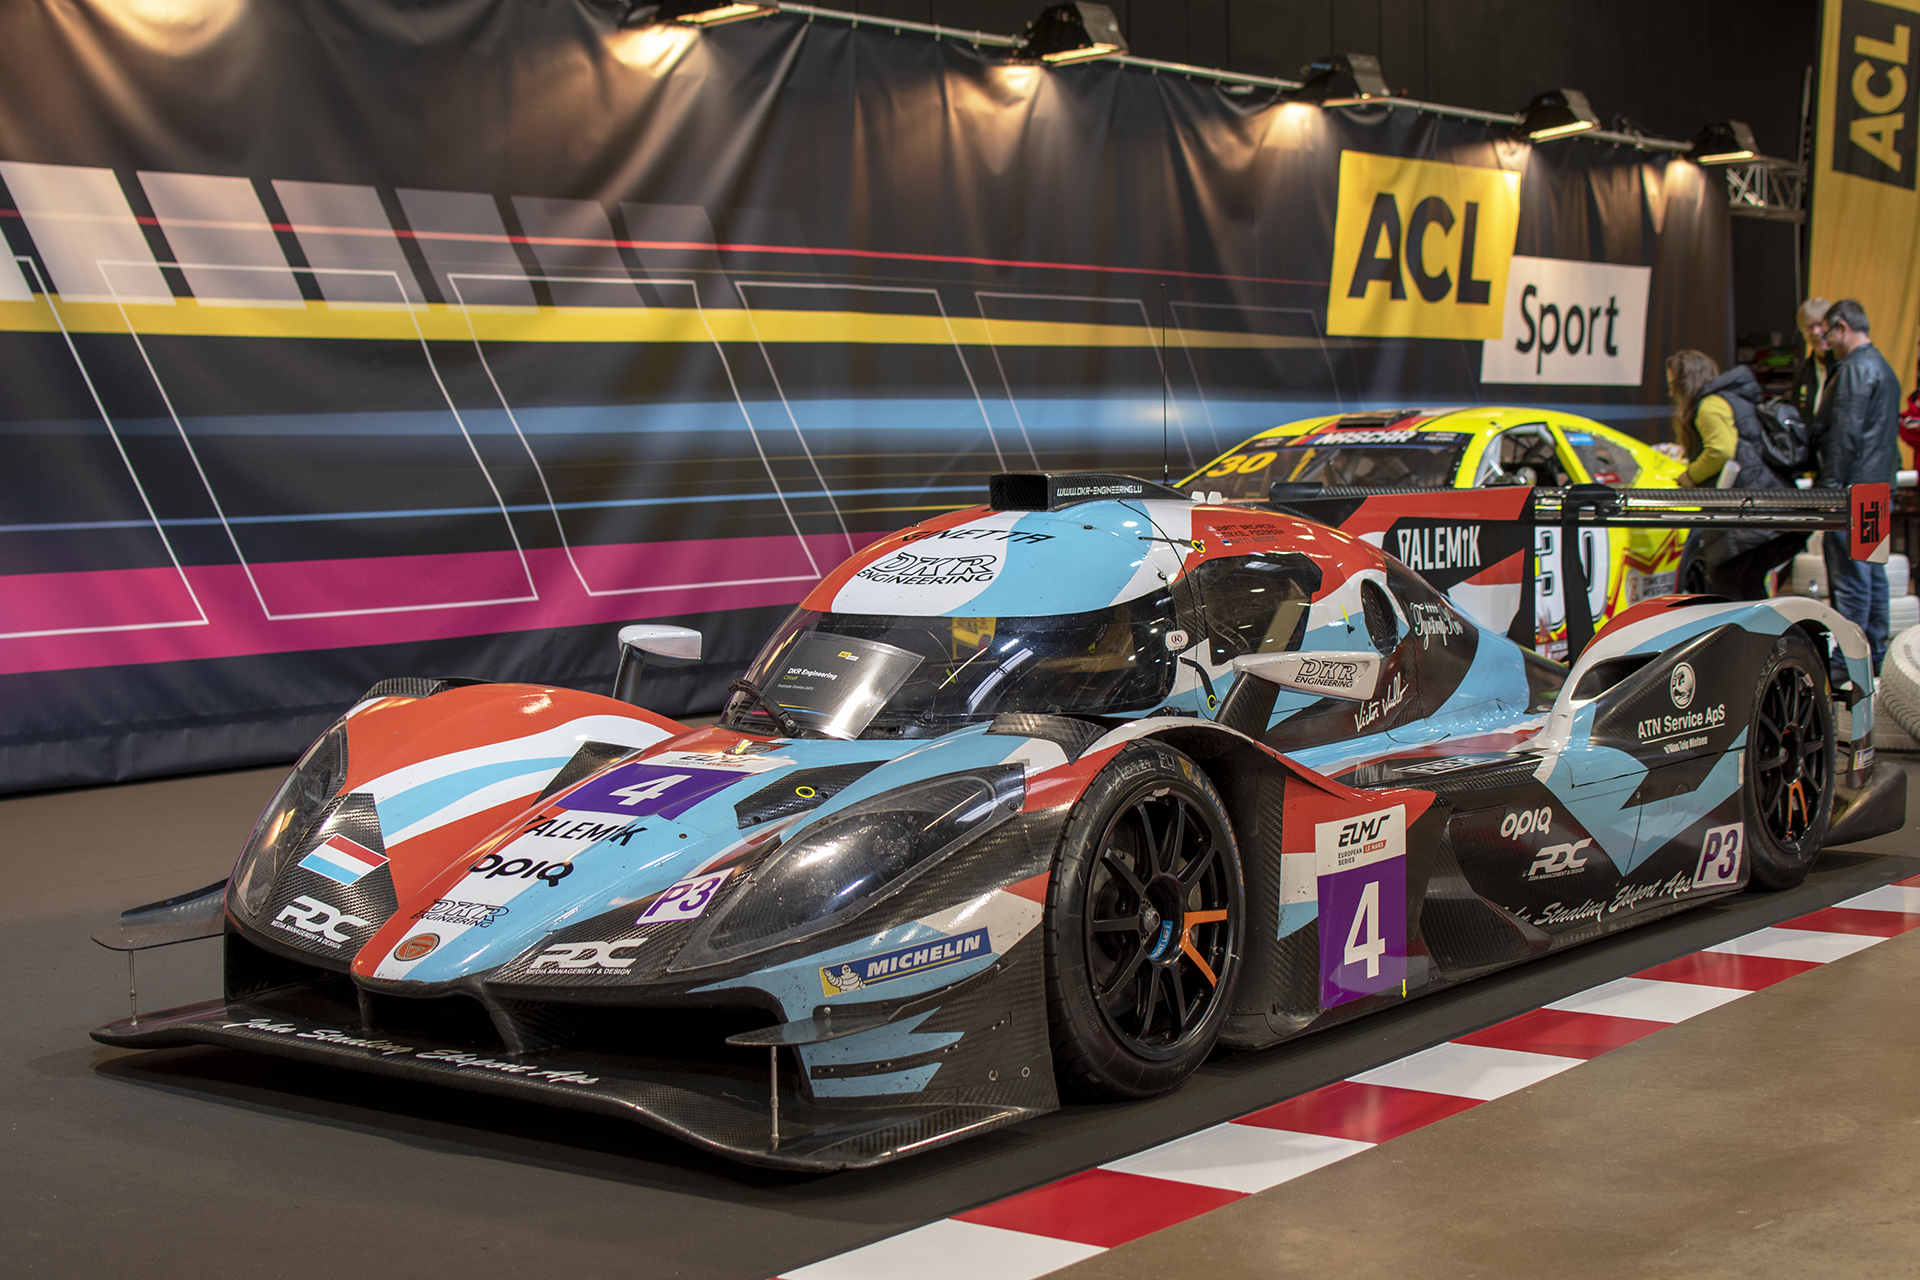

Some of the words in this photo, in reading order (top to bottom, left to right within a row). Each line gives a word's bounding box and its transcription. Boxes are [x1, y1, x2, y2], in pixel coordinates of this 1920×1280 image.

[1849, 24, 1911, 173] ACL
[1347, 191, 1491, 304] ACL
[1516, 284, 1620, 375] Sport
[1313, 430, 1418, 445] NASCAR
[1206, 451, 1278, 477] 30
[902, 529, 1056, 544] GINETTA
[856, 569, 995, 585] ENGINEERING
[871, 551, 997, 576] DKR
[801, 668, 838, 680] Engineering
[1294, 676, 1353, 688] ENGINEERING
[1298, 658, 1358, 680] DKR
[1638, 717, 1661, 739] ATN
[1664, 711, 1703, 732] Service
[1705, 704, 1725, 726] ApS
[609, 774, 692, 806] 4
[1338, 814, 1391, 847] ELMS
[1338, 848, 1363, 859] EUROPEAN
[1371, 841, 1384, 851] MANS
[1338, 857, 1355, 866] SERIES
[1528, 837, 1592, 876] RDC
[1696, 829, 1738, 881] P3
[421, 898, 509, 922] DKR
[645, 877, 721, 918] P3
[275, 895, 371, 942] RDC
[410, 911, 494, 928] ENGINEERING
[1344, 880, 1386, 979] 4
[270, 920, 286, 928] MEDIA
[284, 924, 319, 941] MANAGEMENT
[322, 939, 343, 950] DESIGN
[529, 937, 648, 968] RDC
[867, 935, 980, 978] MICHELIN
